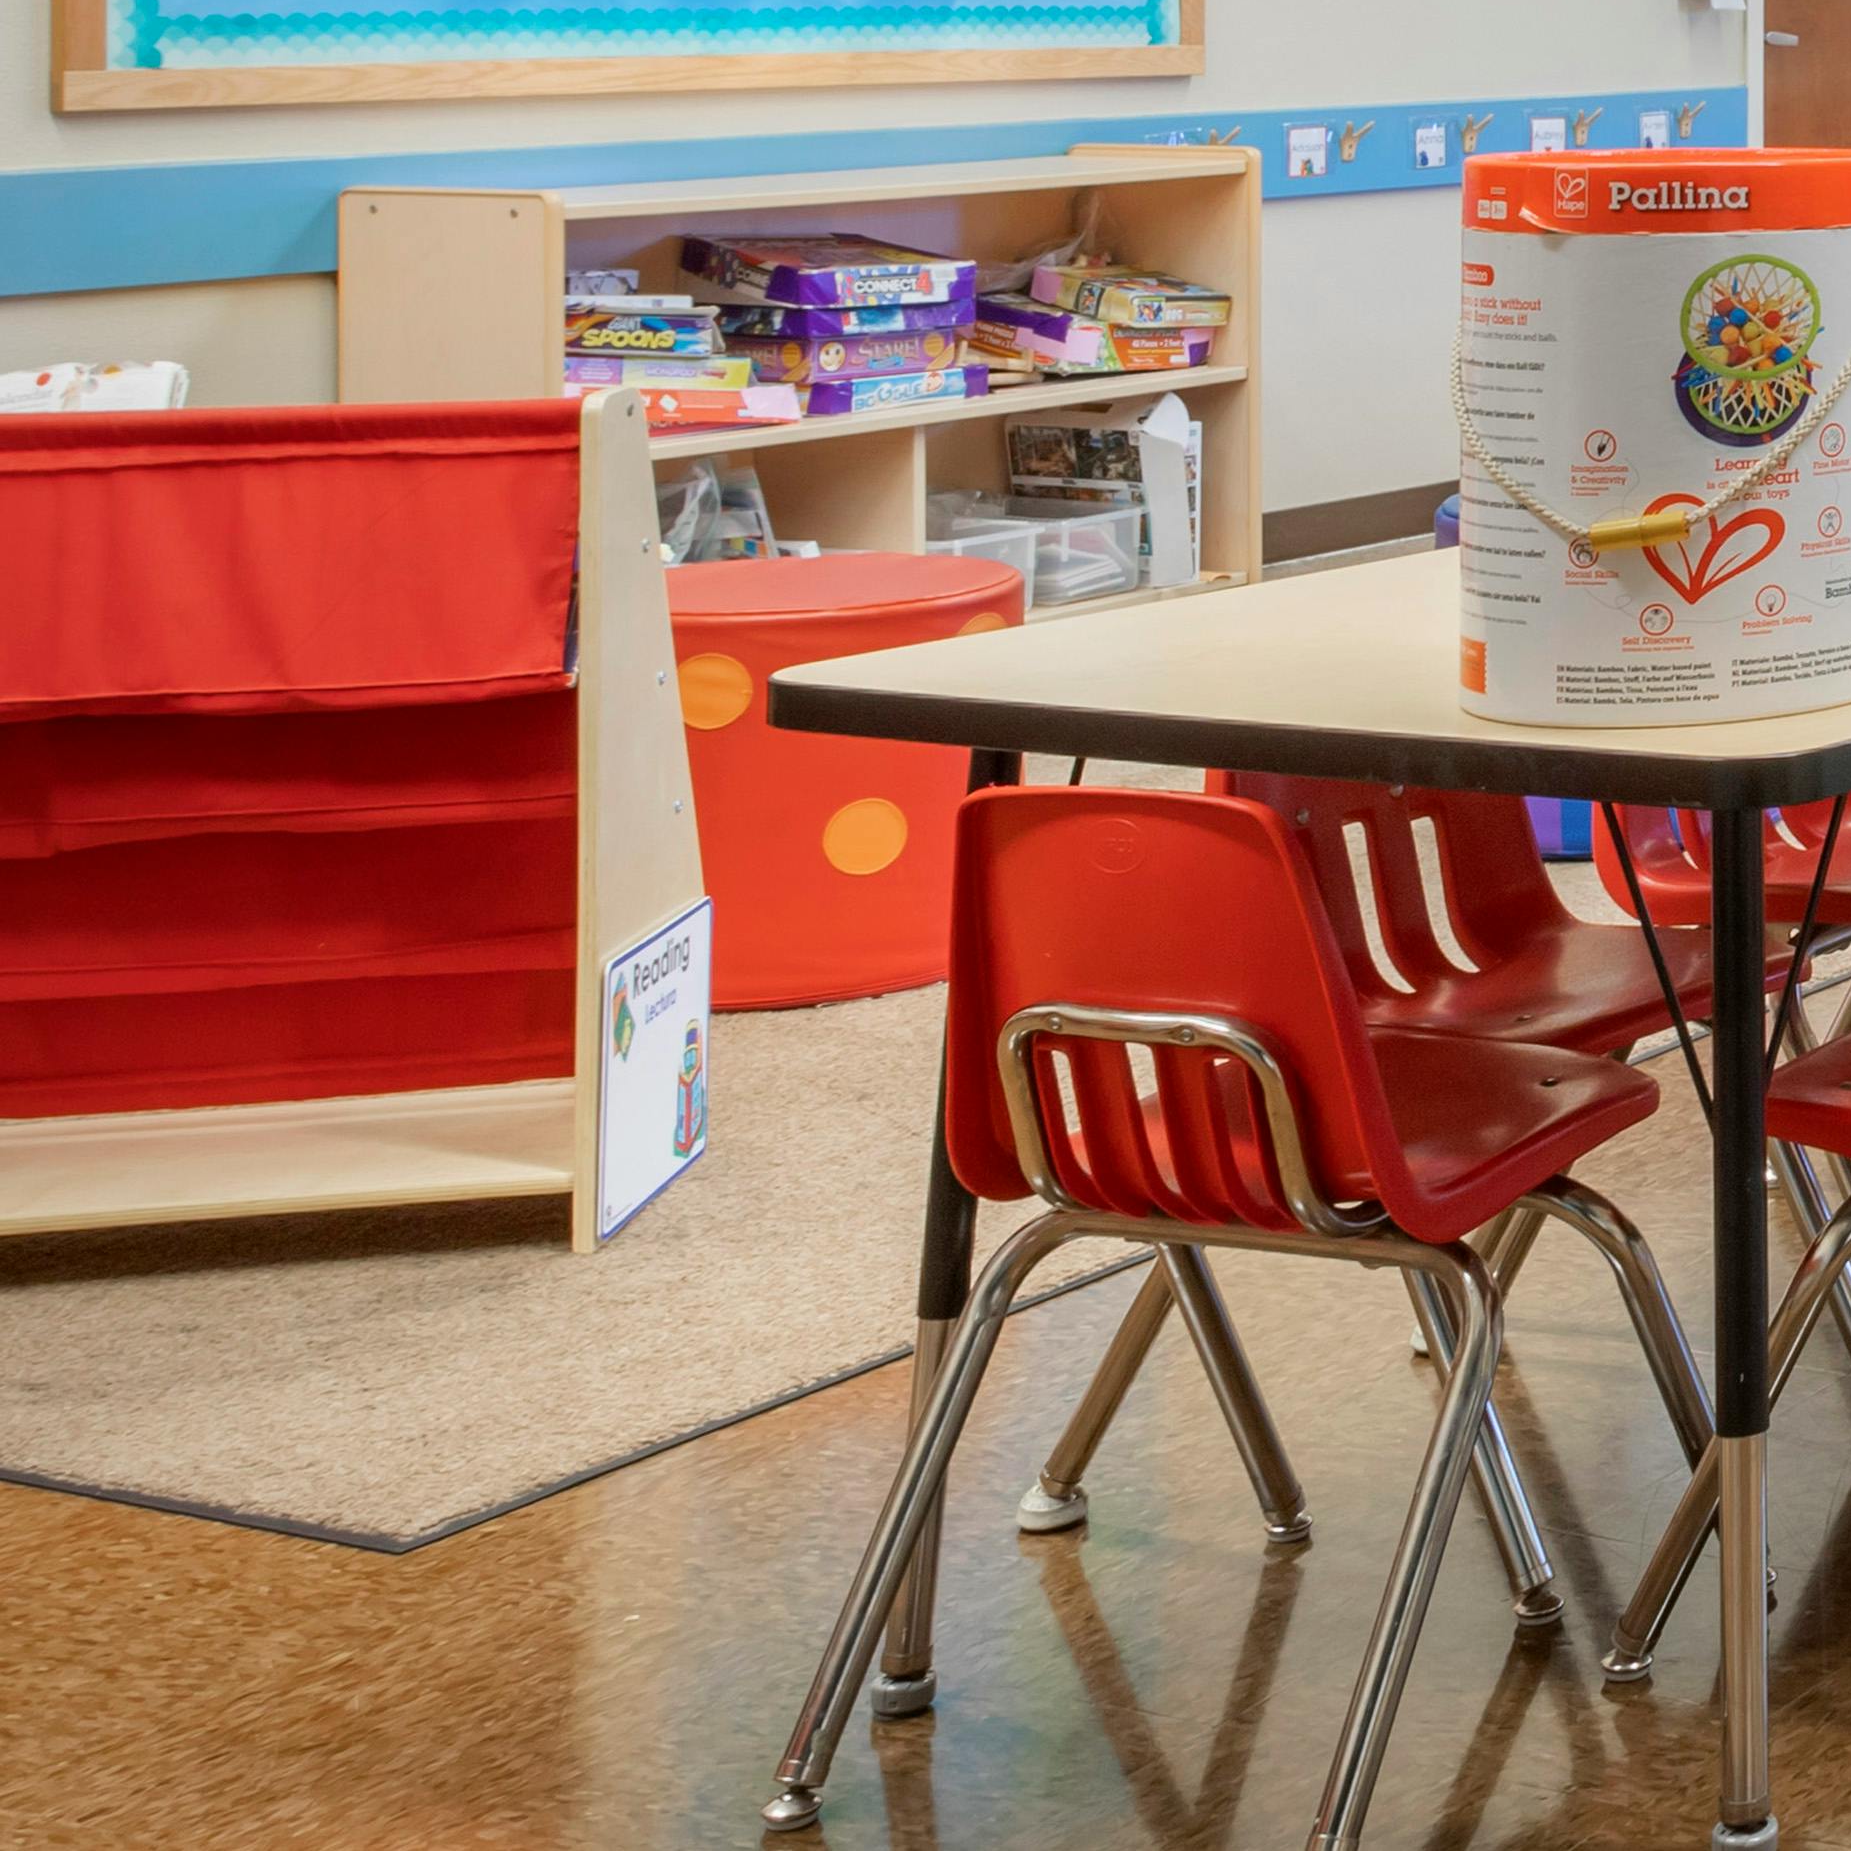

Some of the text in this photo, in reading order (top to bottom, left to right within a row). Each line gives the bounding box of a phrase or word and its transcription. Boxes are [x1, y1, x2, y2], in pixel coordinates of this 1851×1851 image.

[1609, 181, 1749, 210] Pallina
[1557, 199, 1585, 212] Hape
[853, 270, 932, 296] CONNECT 4
[582, 329, 676, 349] SPOONS
[1571, 465, 1629, 474] Imagination
[1580, 476, 1626, 485] Creativity
[1743, 489, 1790, 500] our toys
[1564, 570, 1592, 578] Social
[1742, 615, 1813, 629] Problem Solving
[1622, 636, 1691, 645] Self Discovery
[632, 935, 691, 1000] Reading
[644, 987, 677, 1025] Lectura
